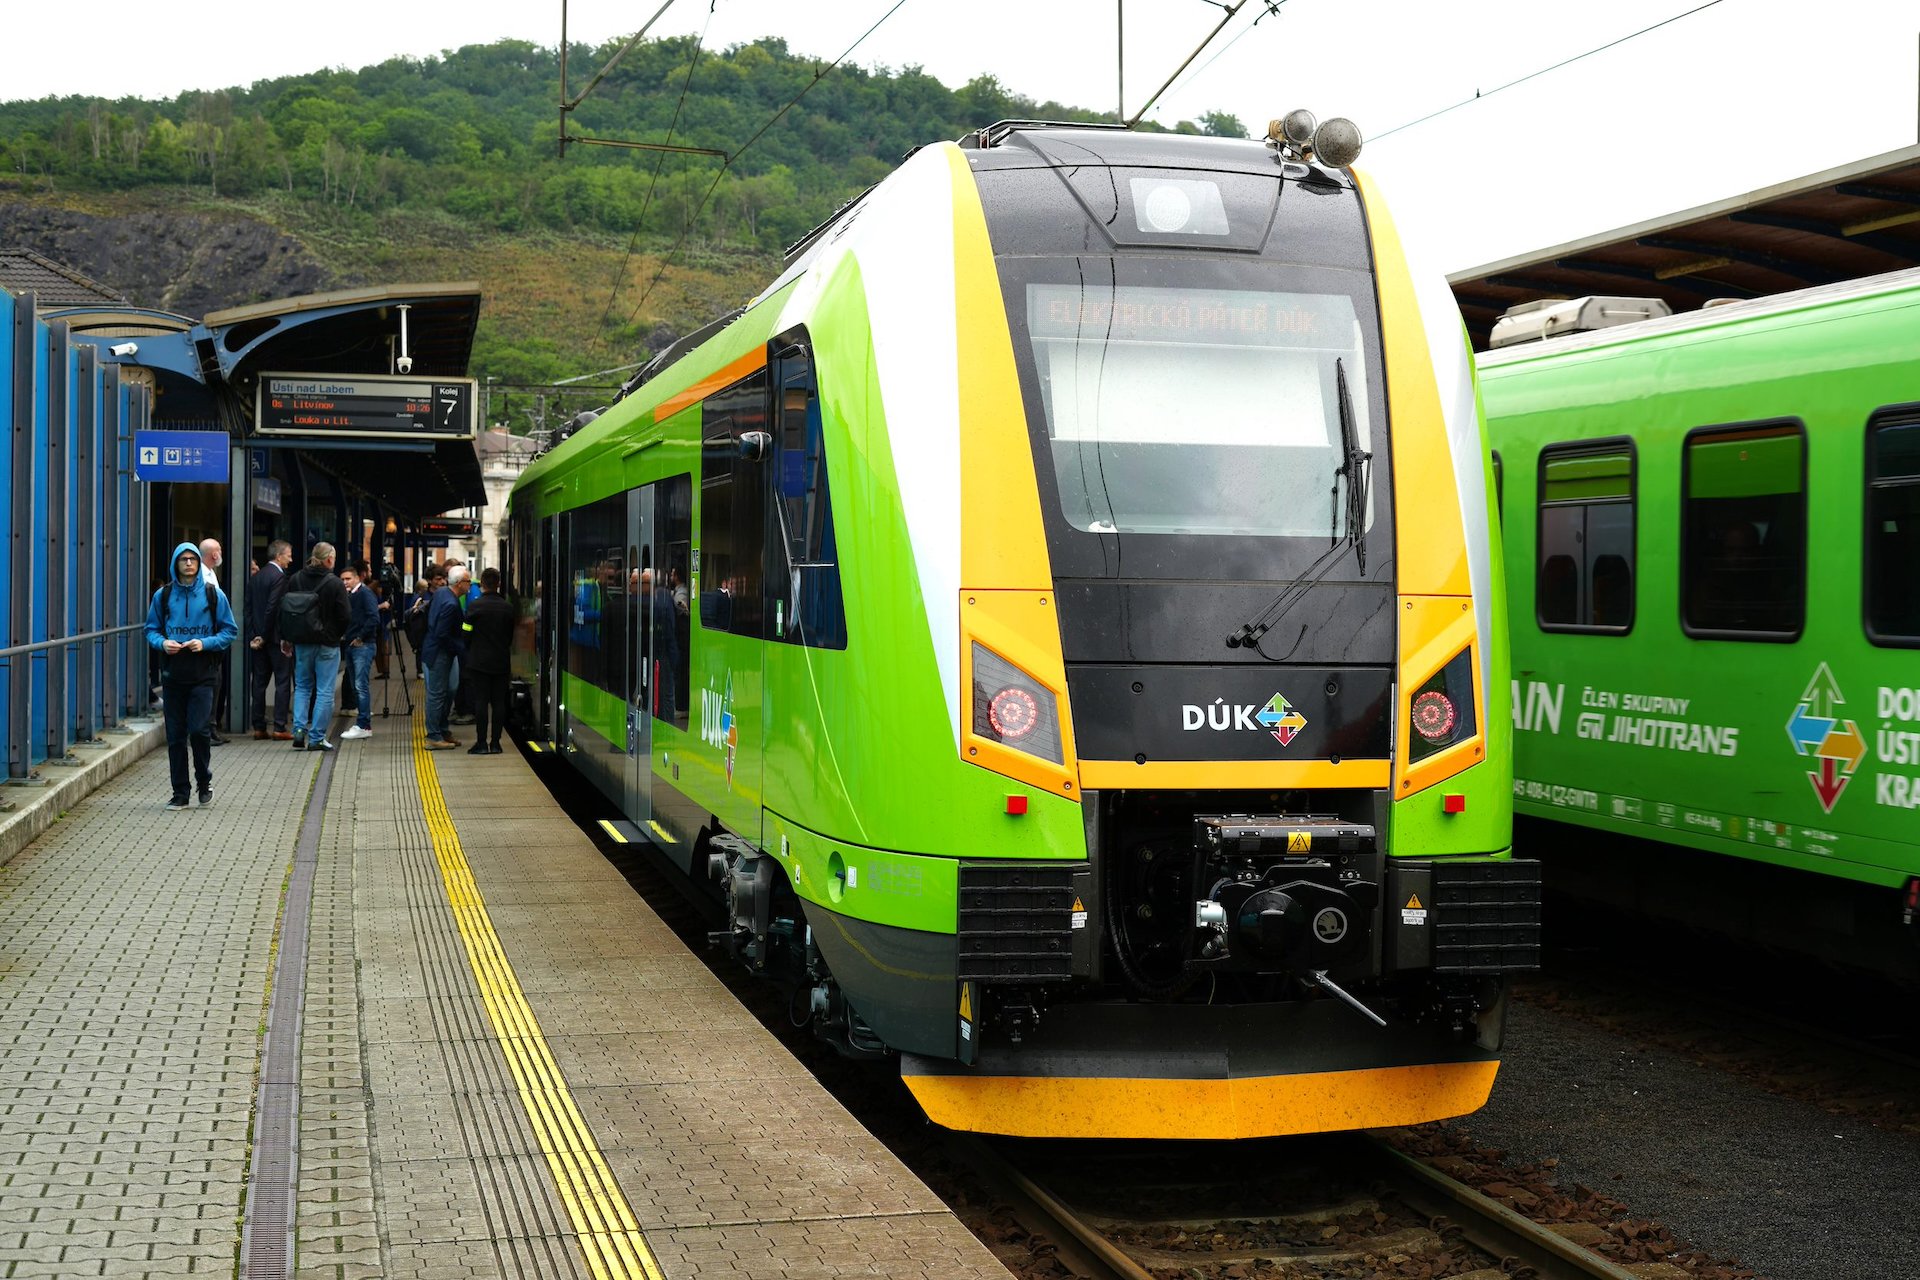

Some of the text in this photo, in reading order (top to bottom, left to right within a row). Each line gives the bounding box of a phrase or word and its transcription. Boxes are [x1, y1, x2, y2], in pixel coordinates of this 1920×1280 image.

[1049, 299, 1191, 328] ELEKTRICKÁ
[273, 381, 354, 394] Ústí nad Labem
[439, 387, 459, 396] Kolej
[293, 400, 334, 409] Litvínov
[405, 403, 431, 413] 10:26
[440, 398, 457, 425] 7
[293, 415, 353, 425] Louka u Lit.
[701, 674, 722, 750] DÚK
[1182, 697, 1258, 731] DÚK
[1581, 686, 1691, 716] ČLEN SKUPINY
[1607, 715, 1740, 757] JIHOTRANS
